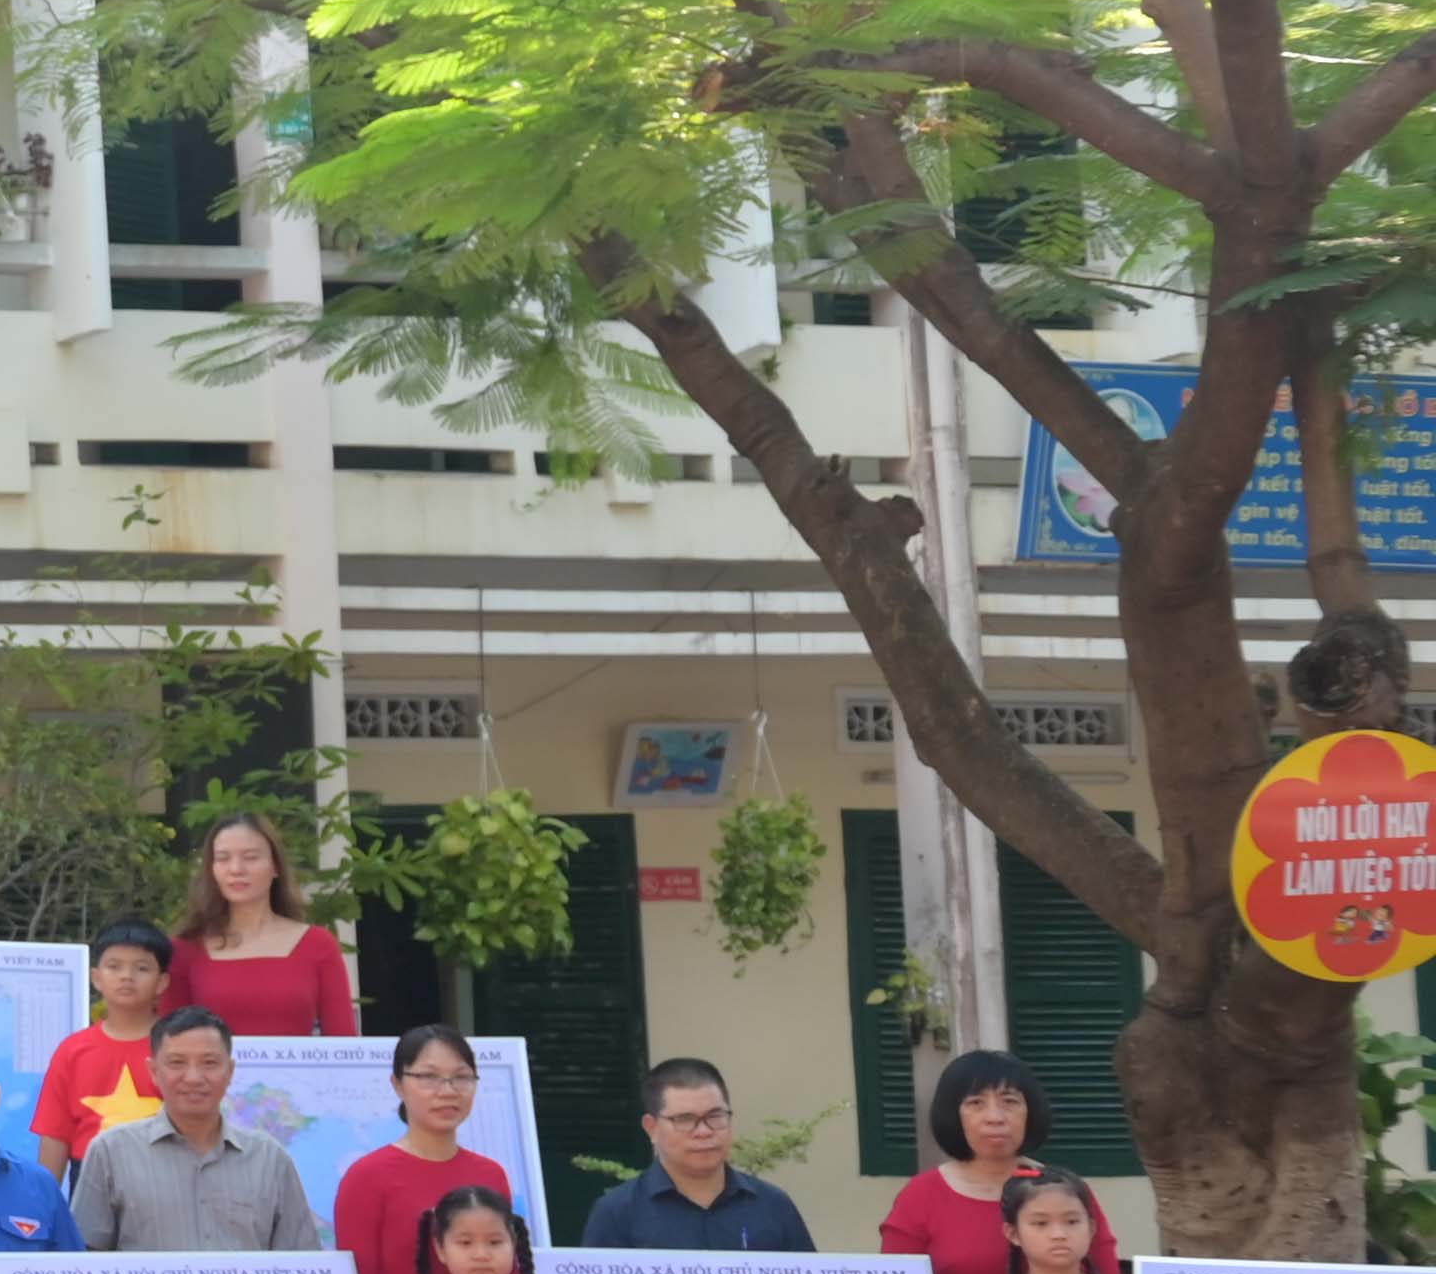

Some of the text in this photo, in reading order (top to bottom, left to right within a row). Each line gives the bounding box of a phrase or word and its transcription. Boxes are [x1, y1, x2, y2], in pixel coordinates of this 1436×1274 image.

[1296, 795, 1430, 843] NÓI LỜI HAY
[1283, 842, 1436, 901] LÀM VIỆC TỐT
